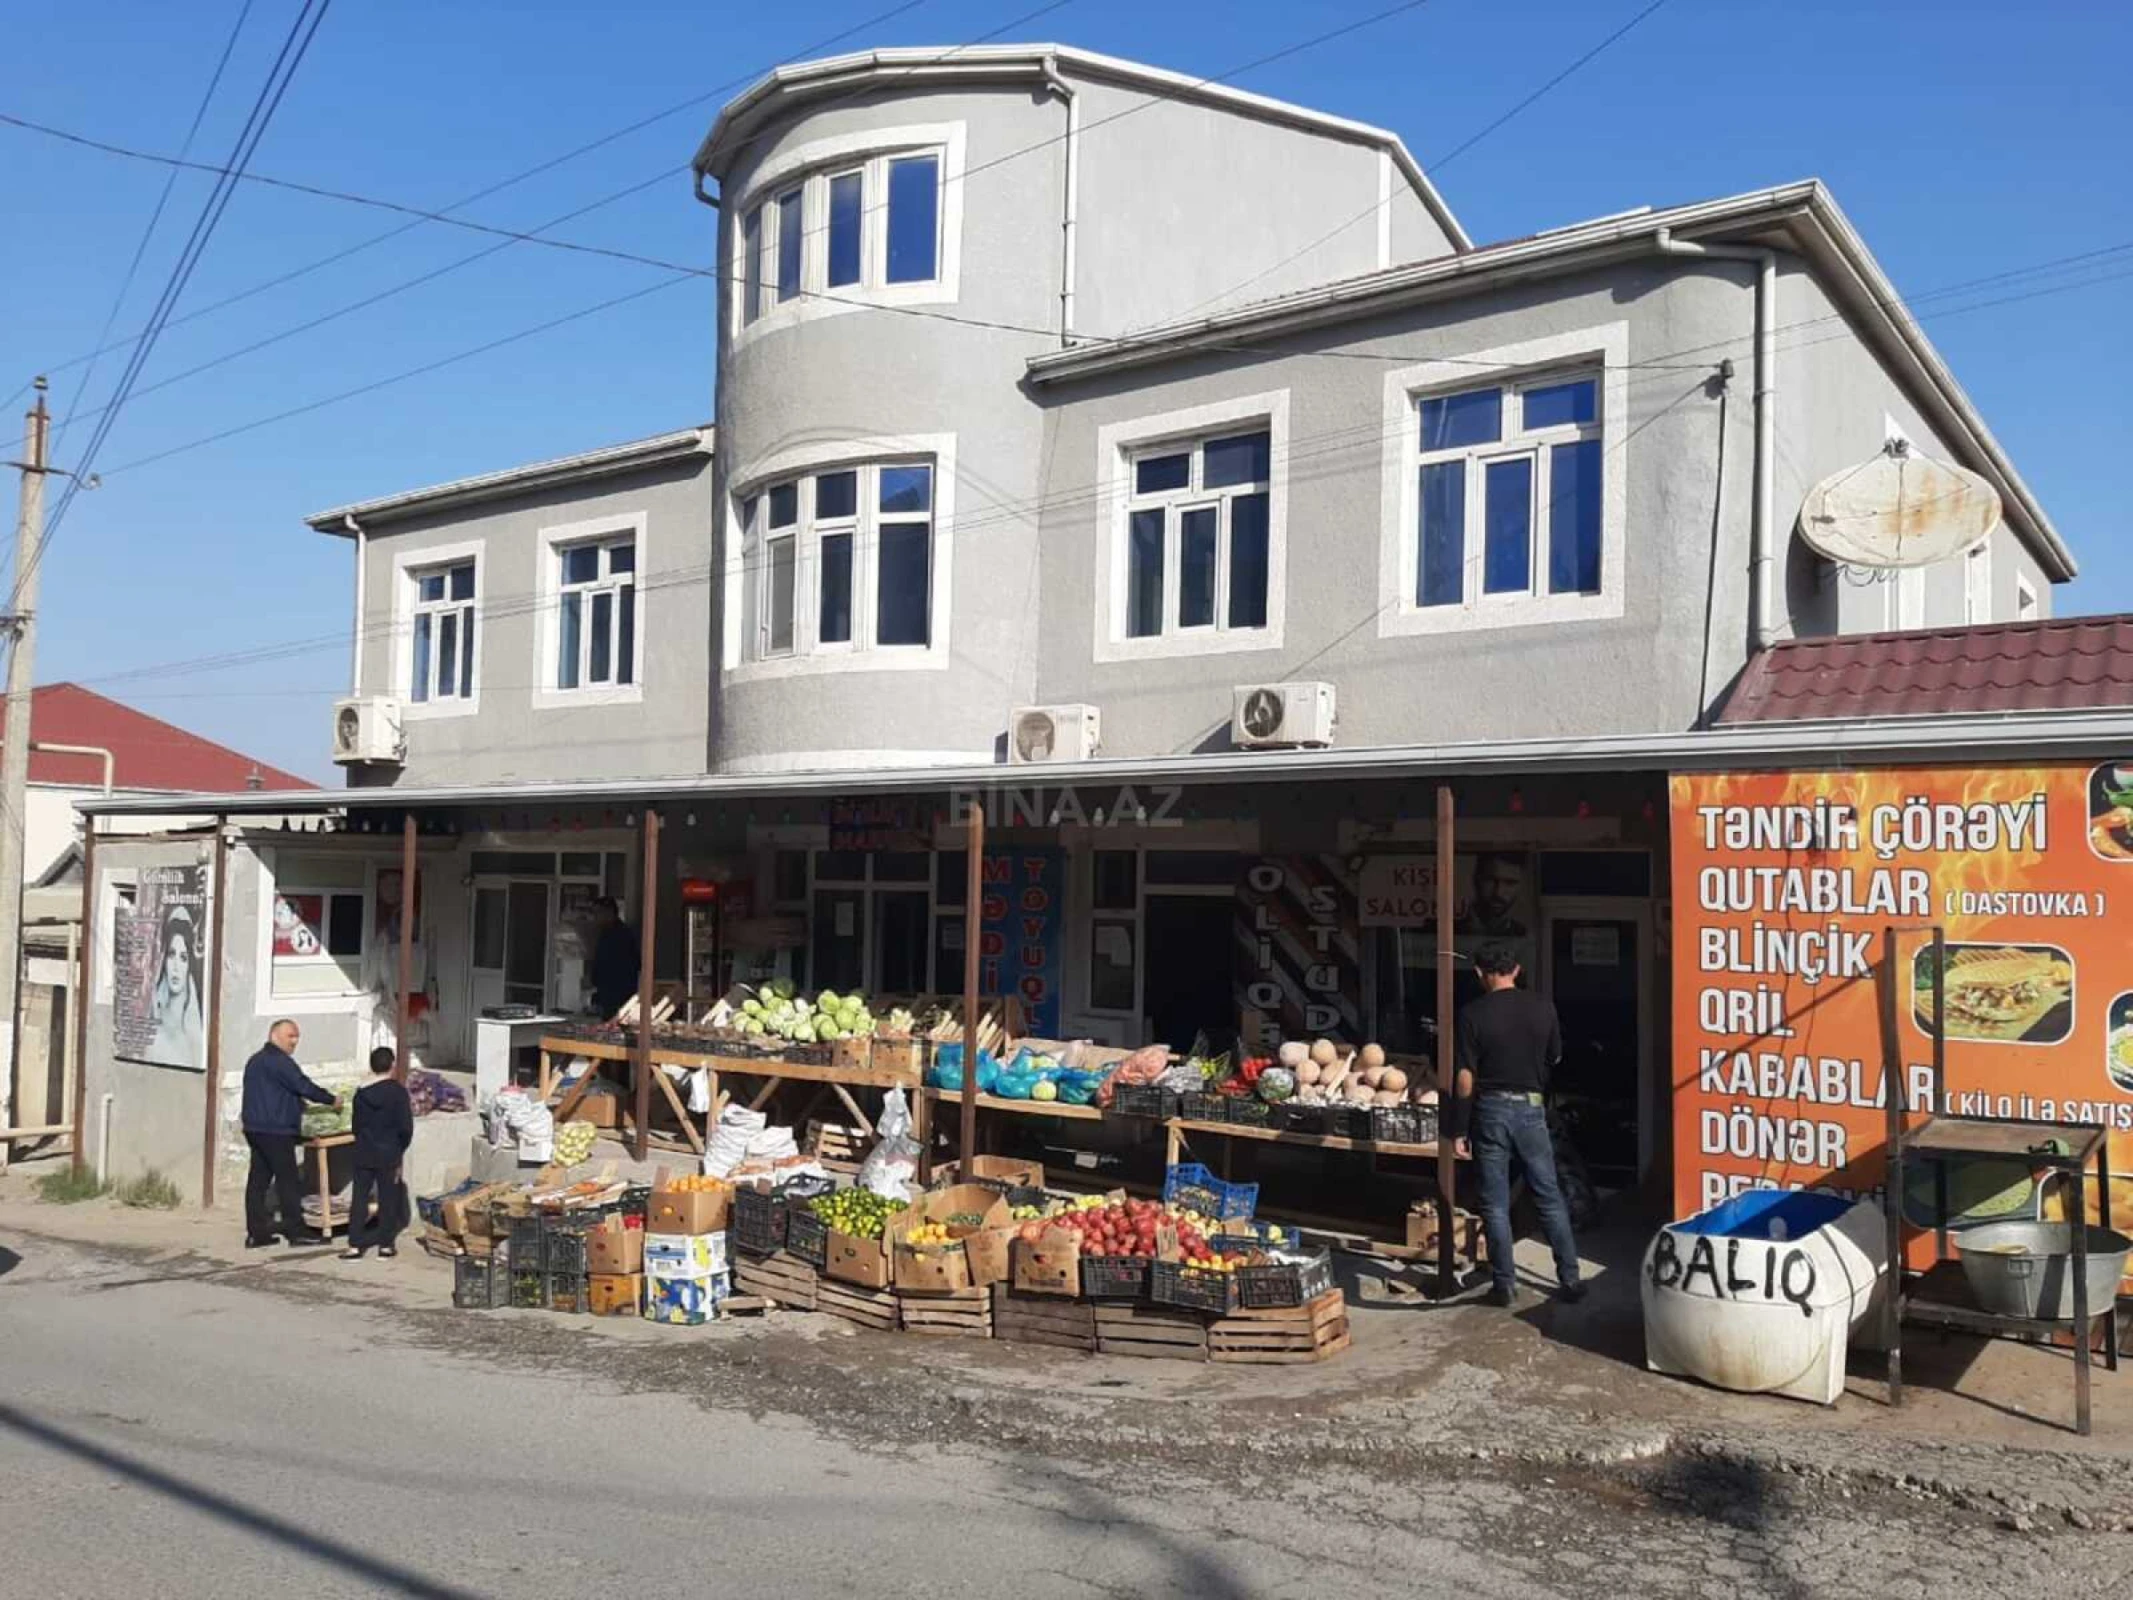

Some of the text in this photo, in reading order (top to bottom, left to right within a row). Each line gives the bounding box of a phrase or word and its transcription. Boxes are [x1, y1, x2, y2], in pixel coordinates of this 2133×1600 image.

[1698, 794, 2047, 859] TƏNDİR ÇÖRƏYİ
[1699, 867, 1931, 916] QUTABLAR
[1961, 892, 2089, 916] DASTOVKA
[1699, 922, 1875, 984] BLİNÇİK
[1699, 984, 1796, 1037] QRİL
[1960, 1089, 2013, 1118] KİLO
[1700, 1106, 1847, 1168] DÖNƏR
[1650, 1231, 1817, 1318] BALIQ
